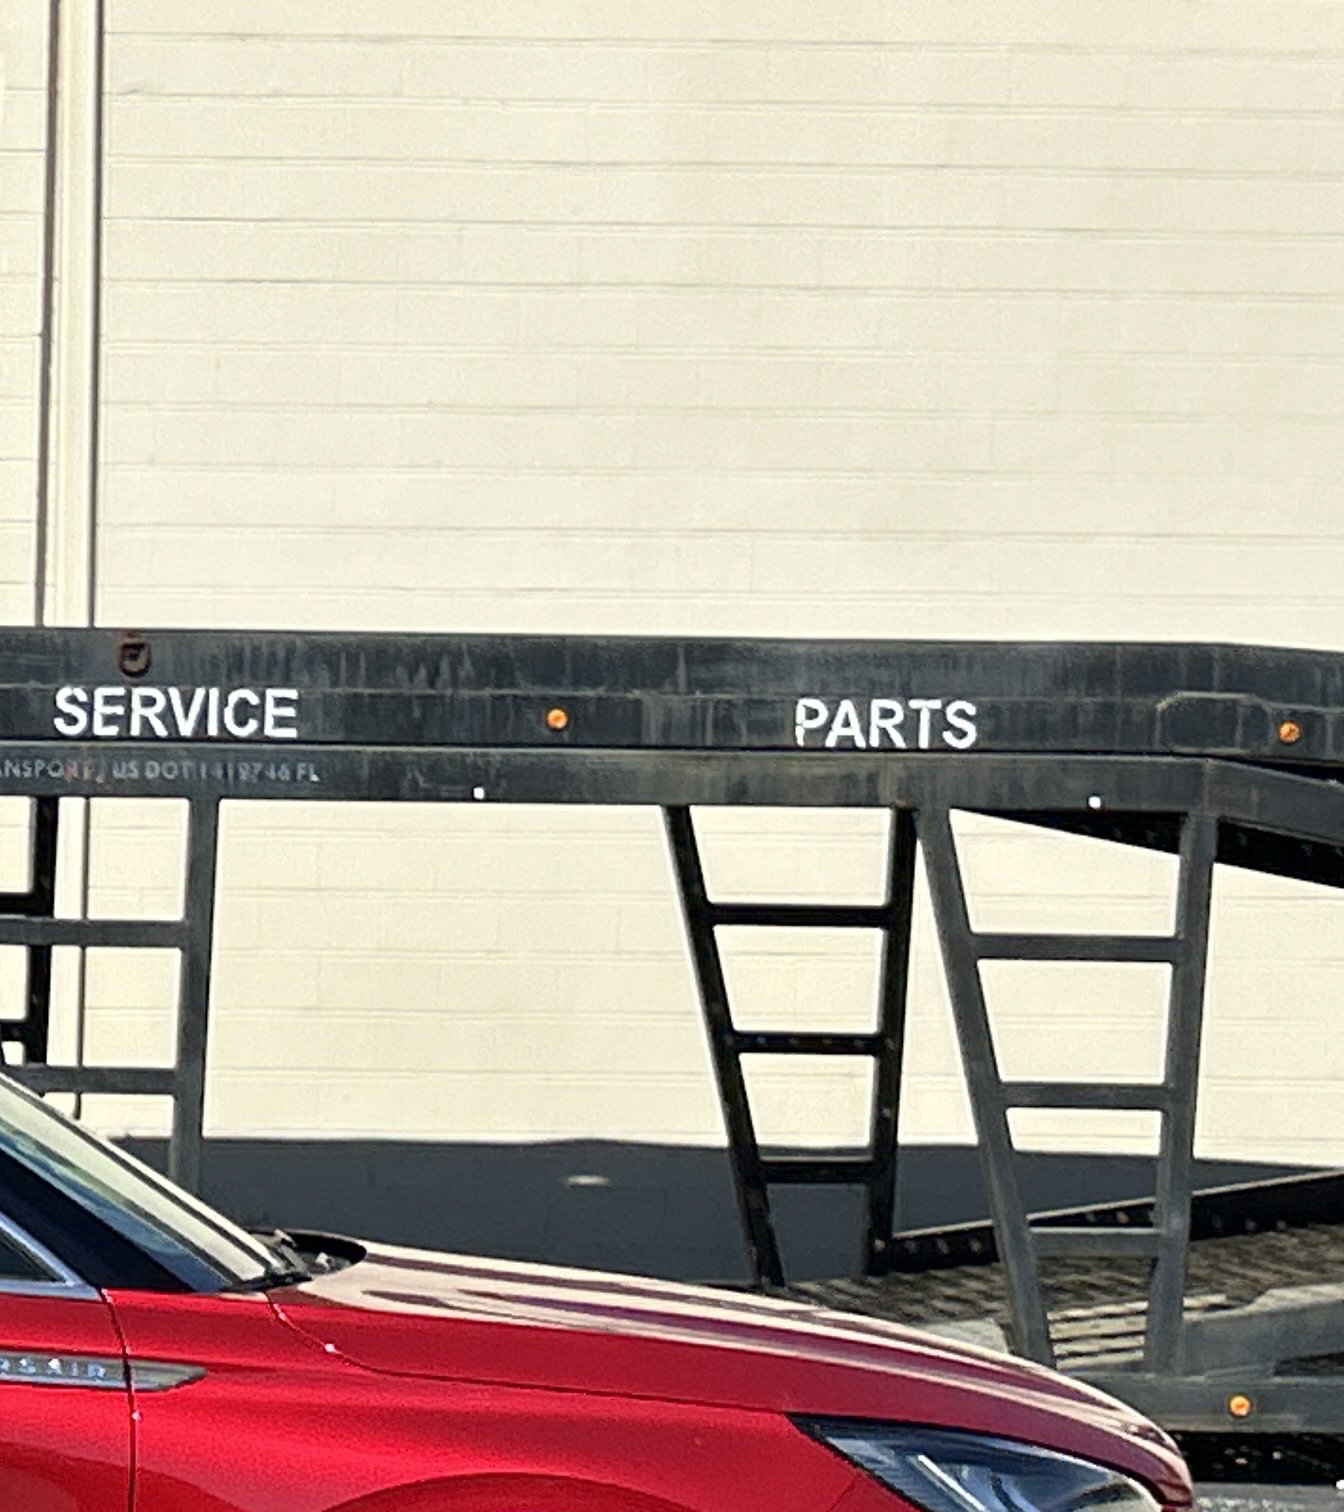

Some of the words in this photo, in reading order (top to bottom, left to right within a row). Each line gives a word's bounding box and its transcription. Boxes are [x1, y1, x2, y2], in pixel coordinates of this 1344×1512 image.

[53, 687, 299, 738] SERVICE
[795, 698, 978, 749] PARTS
[112, 760, 140, 780] US
[144, 760, 196, 780] DOT
[295, 761, 321, 782] FL
